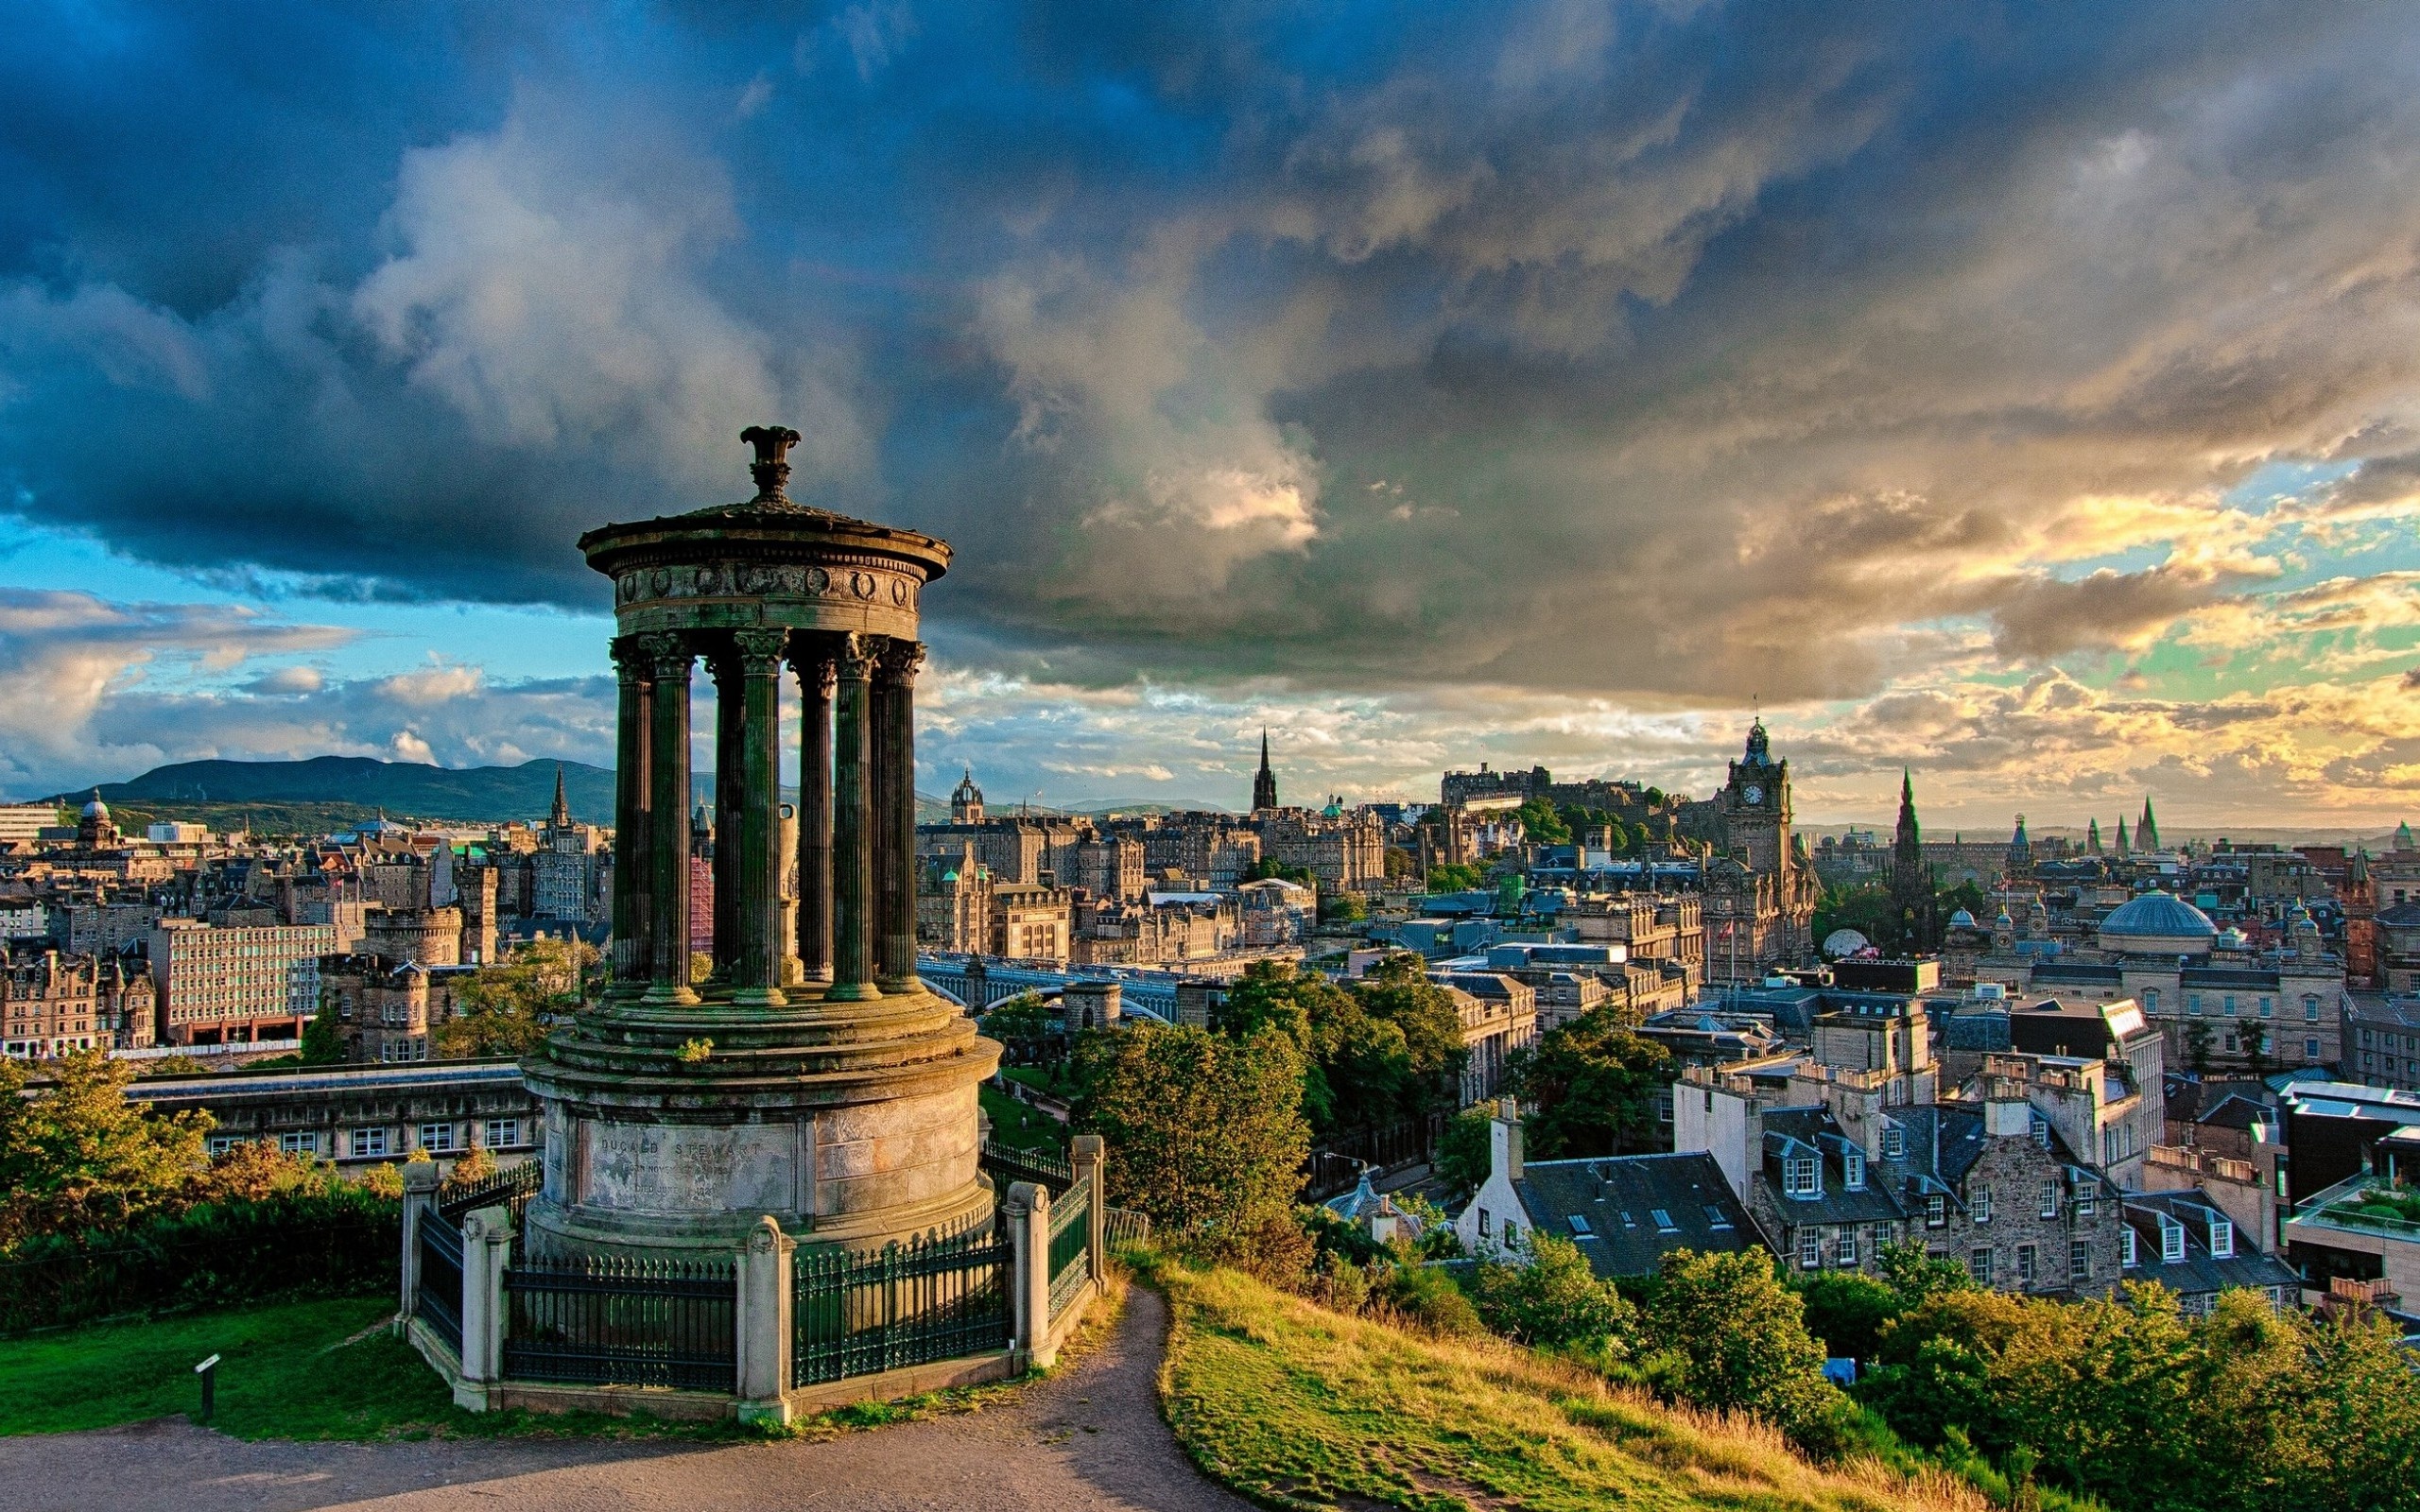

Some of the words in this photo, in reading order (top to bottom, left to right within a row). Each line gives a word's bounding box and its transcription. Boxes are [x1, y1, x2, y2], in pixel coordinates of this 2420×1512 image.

[675, 1143, 762, 1155] STEWART
[635, 1185, 653, 1194] DIED
[657, 1186, 678, 1195] JUNE
